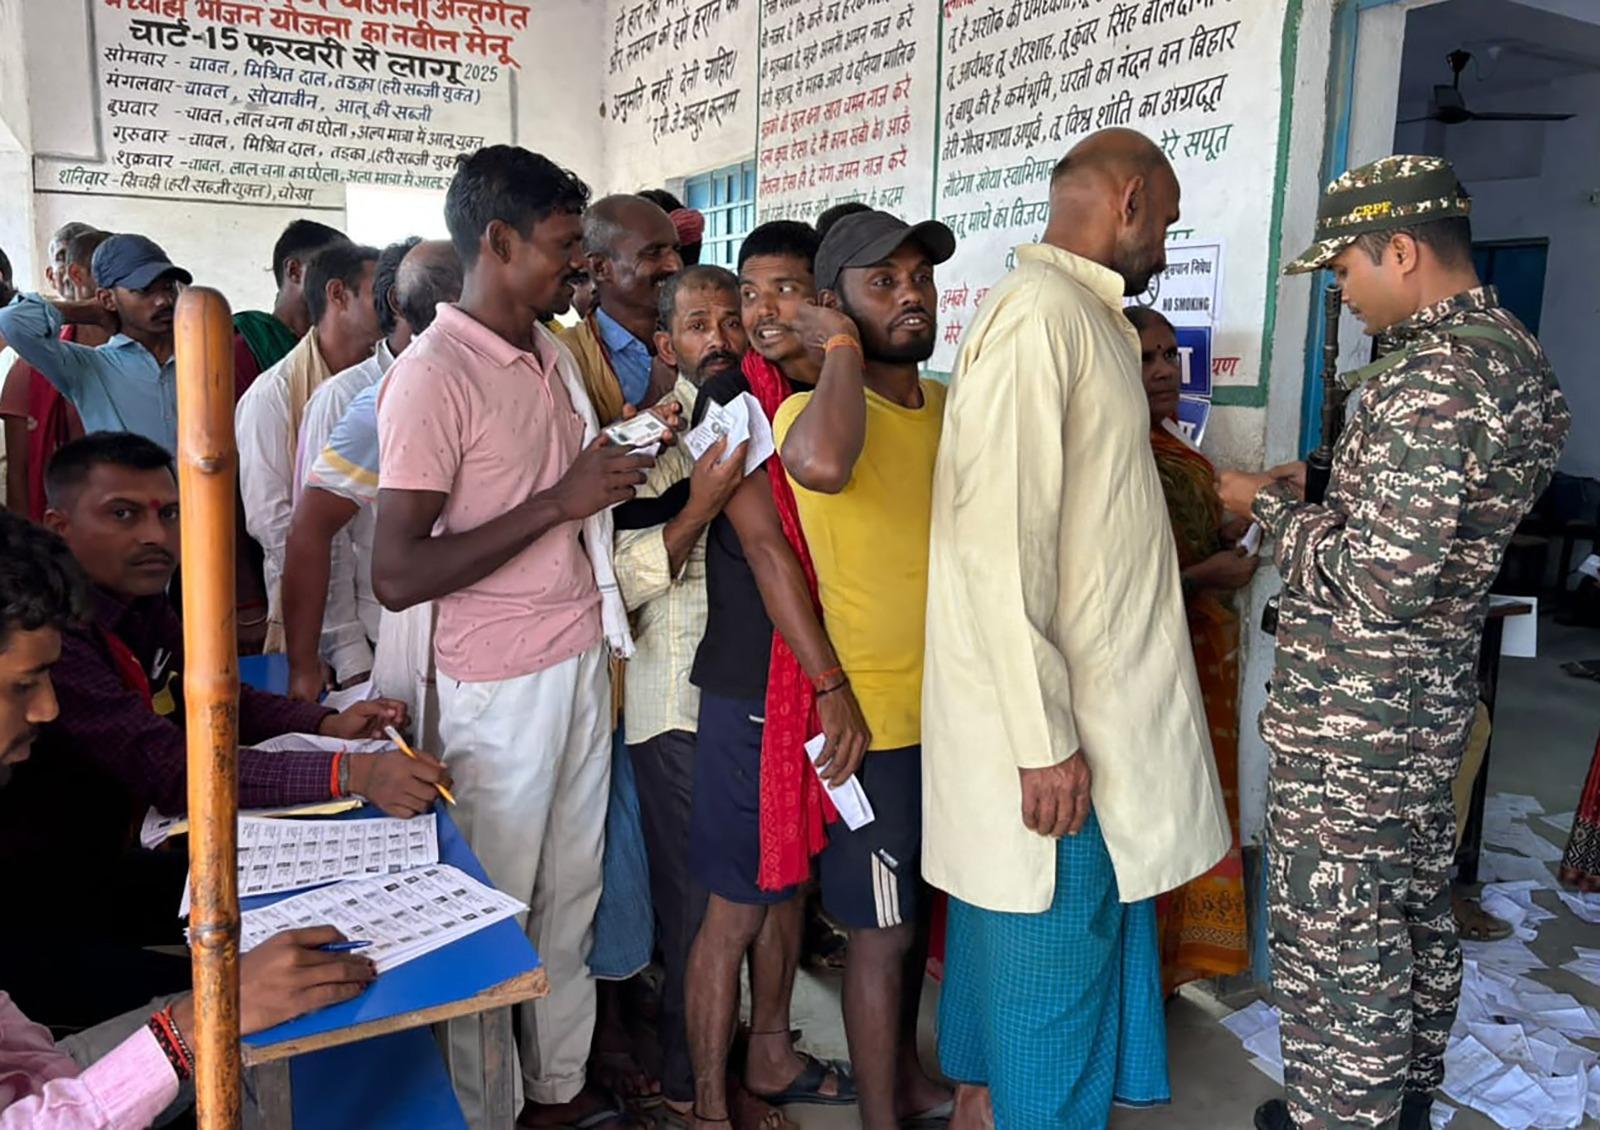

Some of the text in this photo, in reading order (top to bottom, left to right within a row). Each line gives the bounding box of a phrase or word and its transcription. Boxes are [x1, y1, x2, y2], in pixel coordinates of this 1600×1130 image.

[270, 3, 352, 39] योजना
[361, 21, 389, 45] का
[392, 20, 460, 53] नवीन
[464, 26, 521, 69] मेनू
[1188, 20, 1242, 61] बिहार
[104, 43, 168, 68] सोमवार
[245, 33, 348, 69] फरवरी
[353, 43, 380, 73] से
[385, 51, 465, 87] लागू
[464, 63, 498, 82] 2025
[233, 111, 263, 128] लाल
[335, 99, 371, 120] आलू
[372, 101, 391, 118] की
[1183, 123, 1234, 161] सपूत
[1352, 201, 1392, 218] CRPF
[1174, 297, 1210, 311] SMOKING
